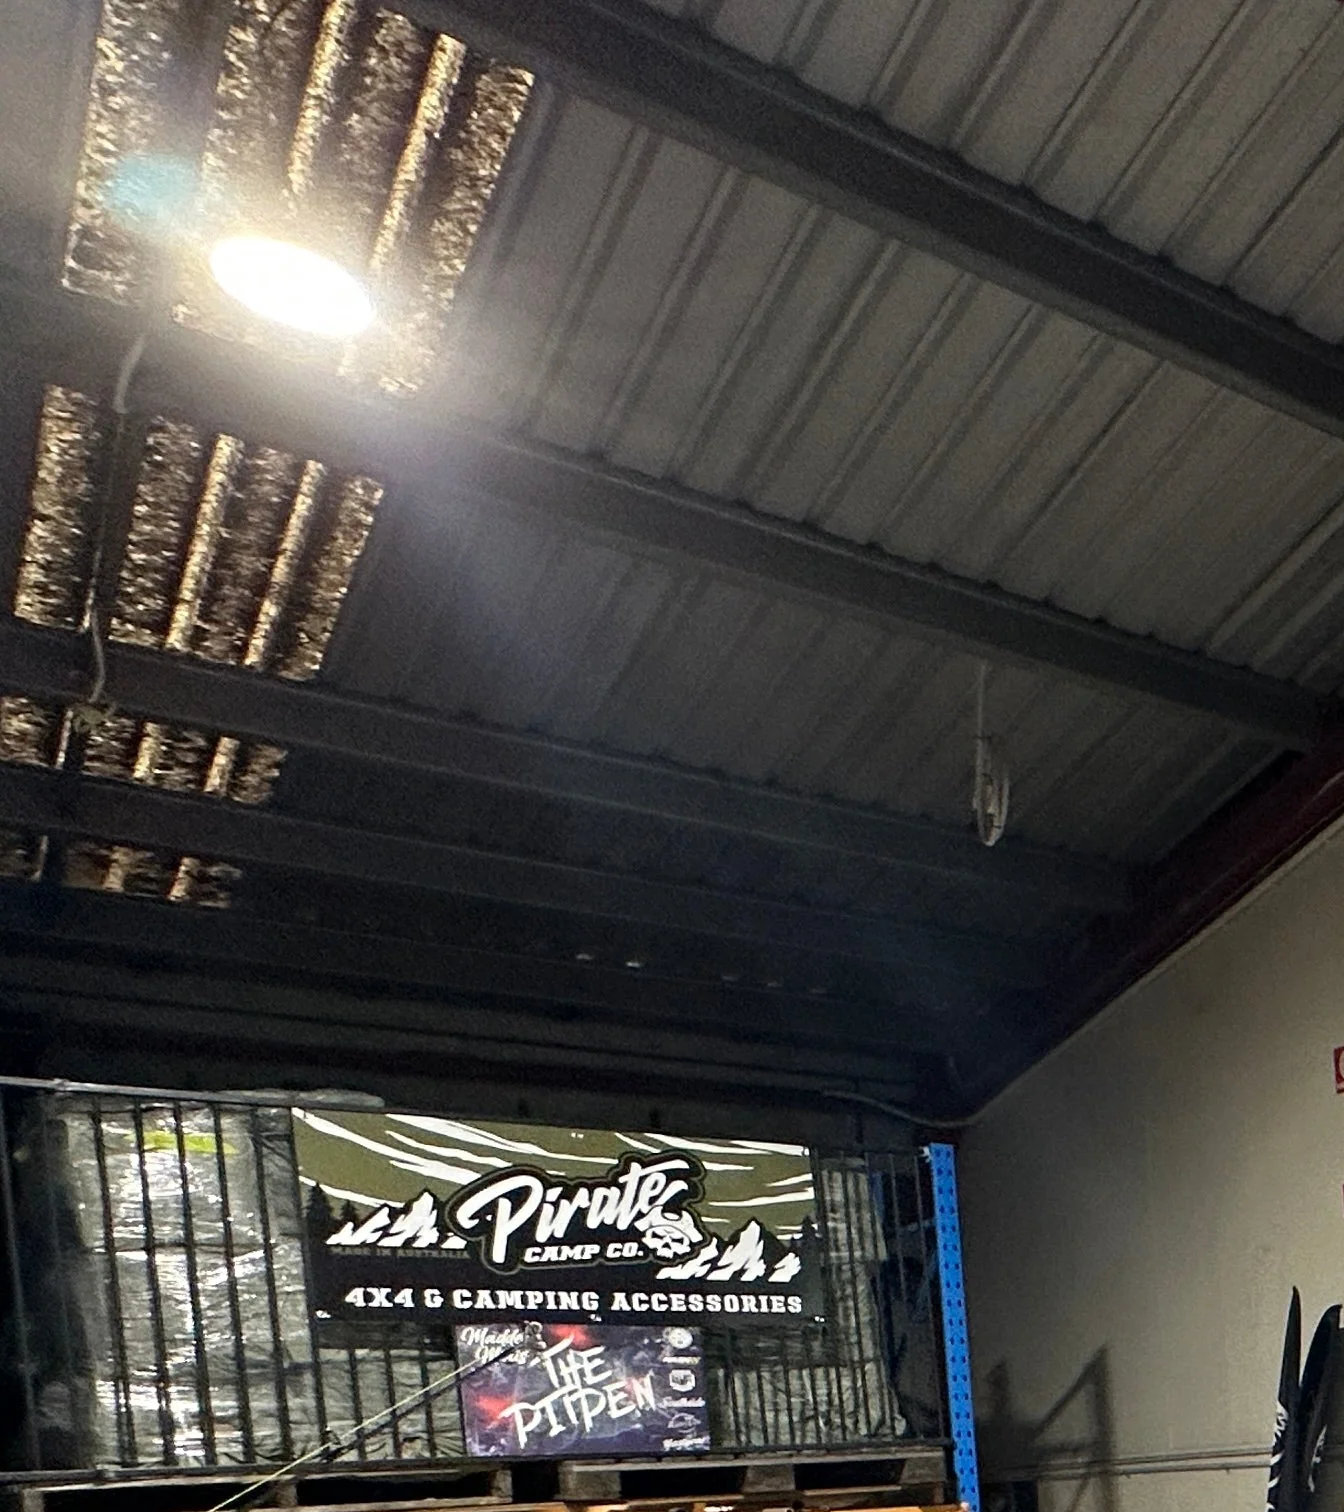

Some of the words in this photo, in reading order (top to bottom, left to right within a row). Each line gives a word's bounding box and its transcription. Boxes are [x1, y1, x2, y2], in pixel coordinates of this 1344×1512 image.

[457, 1159, 690, 1264] Pirate
[524, 1244, 600, 1263] CAMP
[606, 1242, 644, 1259] CO.
[344, 1287, 414, 1308] 4X4
[452, 1289, 600, 1311] CAMPING
[610, 1291, 802, 1314] ACCESSORIES
[530, 1334, 613, 1389] THE
